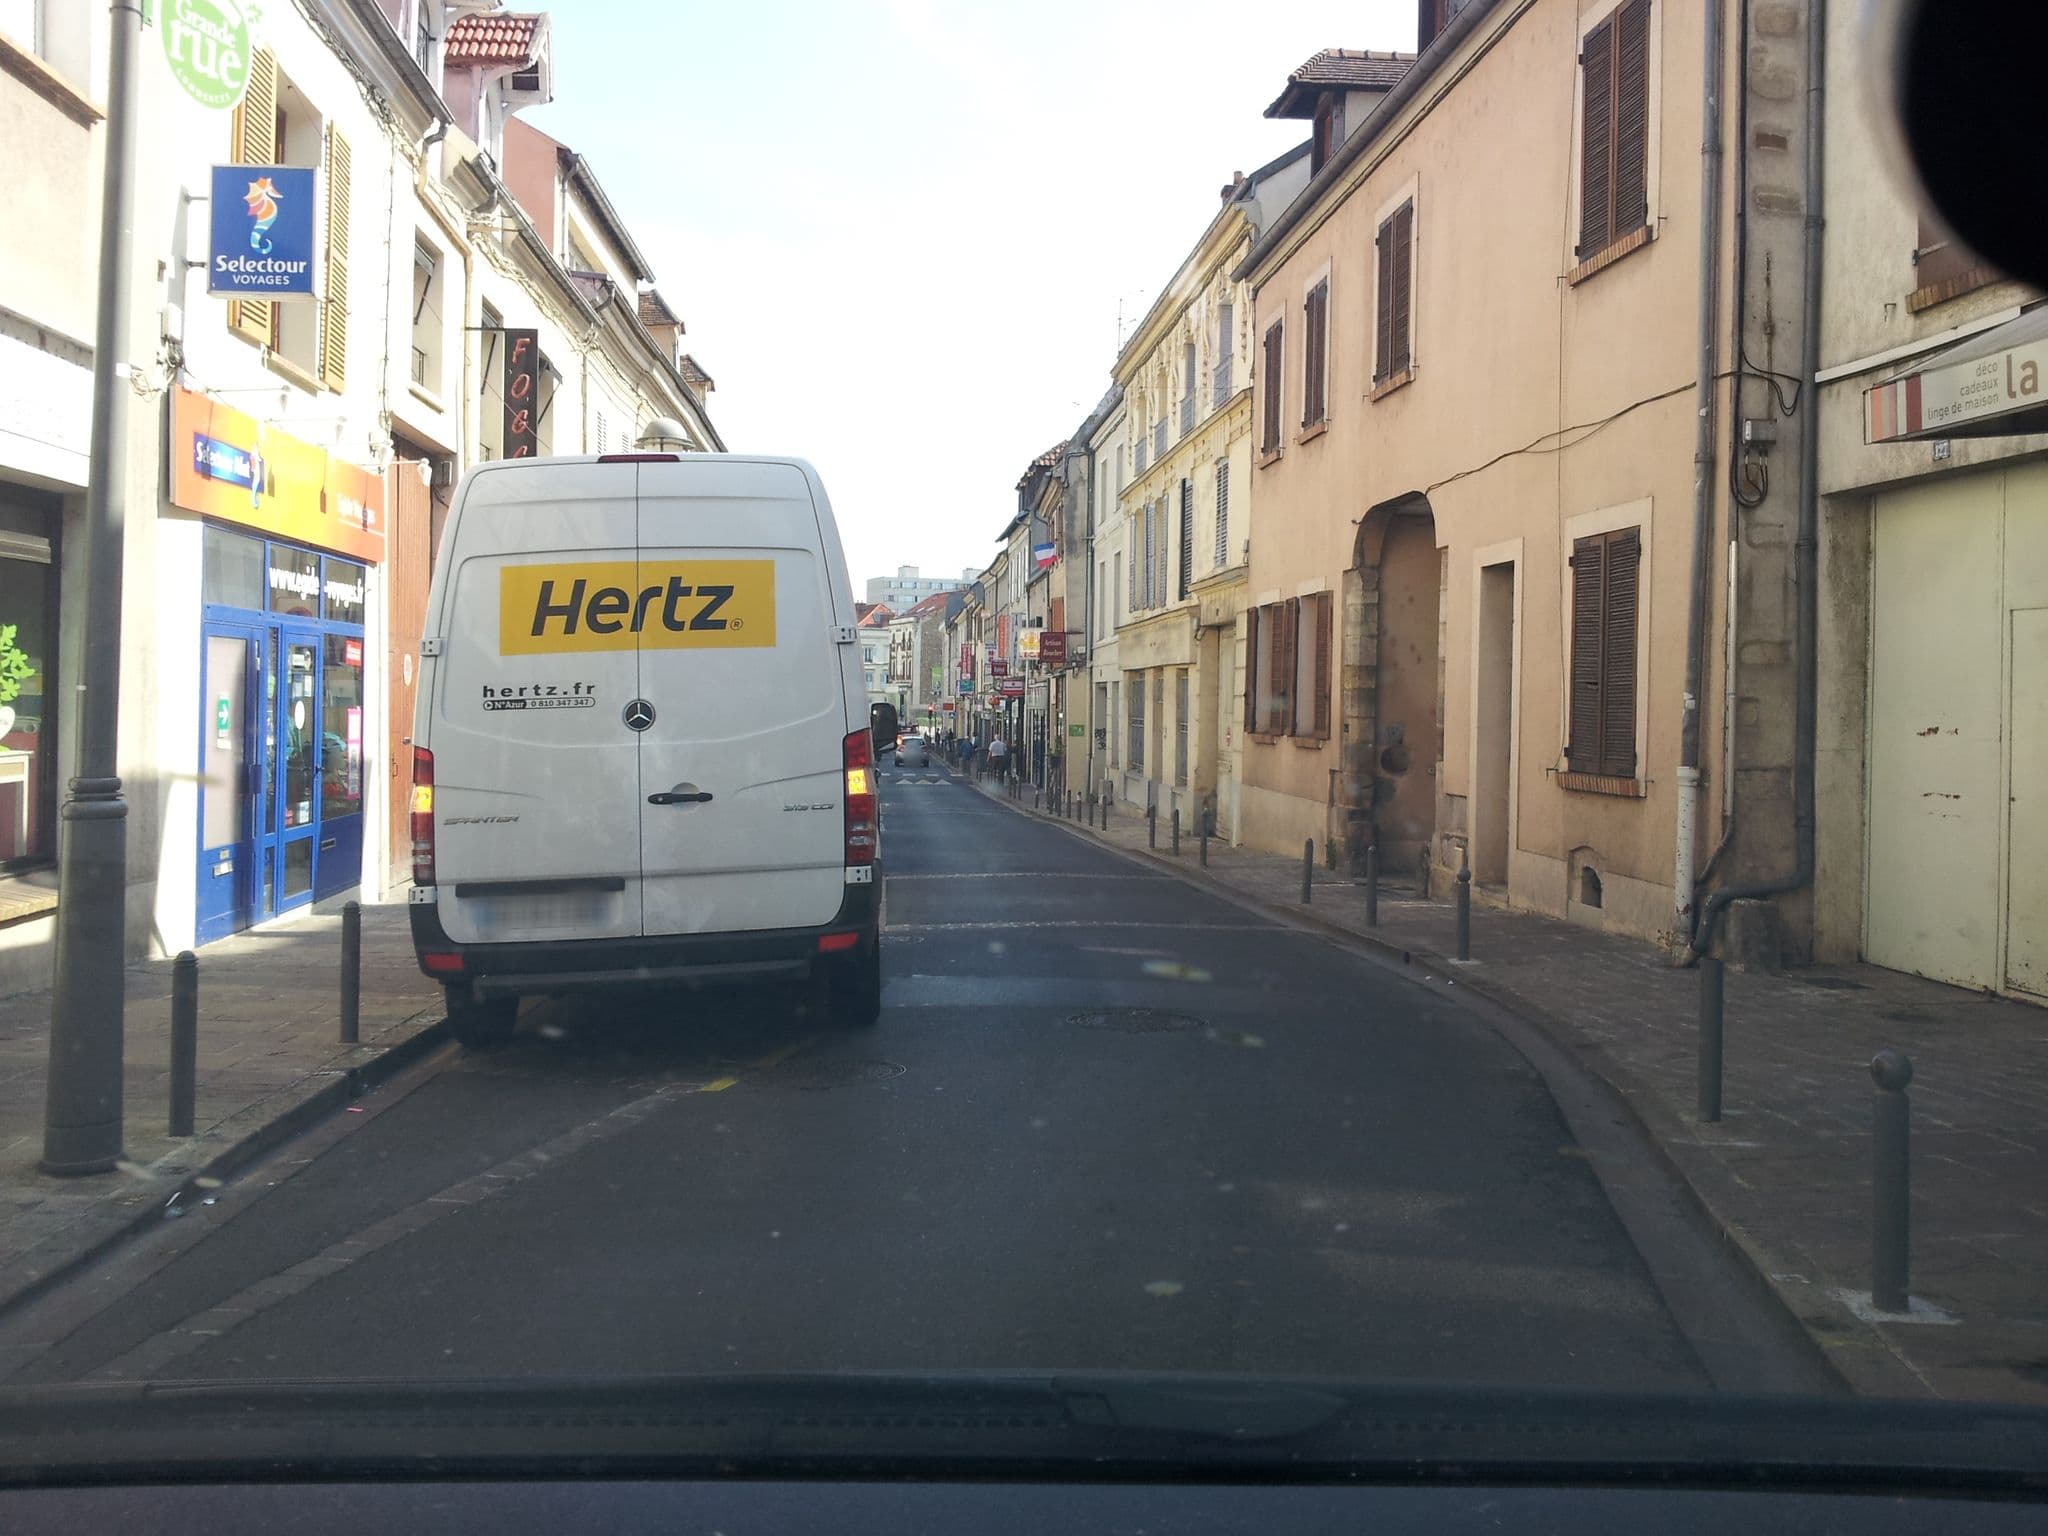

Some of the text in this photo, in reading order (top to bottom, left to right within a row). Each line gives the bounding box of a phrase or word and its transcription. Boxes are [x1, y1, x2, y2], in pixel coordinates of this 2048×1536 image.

[170, 20, 242, 89] rue
[215, 255, 307, 273] Selectour
[232, 274, 290, 285] VOYAGES
[1975, 361, 1999, 377] déco
[2005, 353, 2039, 399] la
[1960, 378, 1999, 397] cadeaux
[1927, 393, 1999, 421] linge de maison
[531, 576, 734, 637] Hertz
[482, 682, 596, 699] hertz.fr
[539, 700, 554, 708] 810
[556, 699, 572, 707] 347
[574, 698, 589, 707] 347
